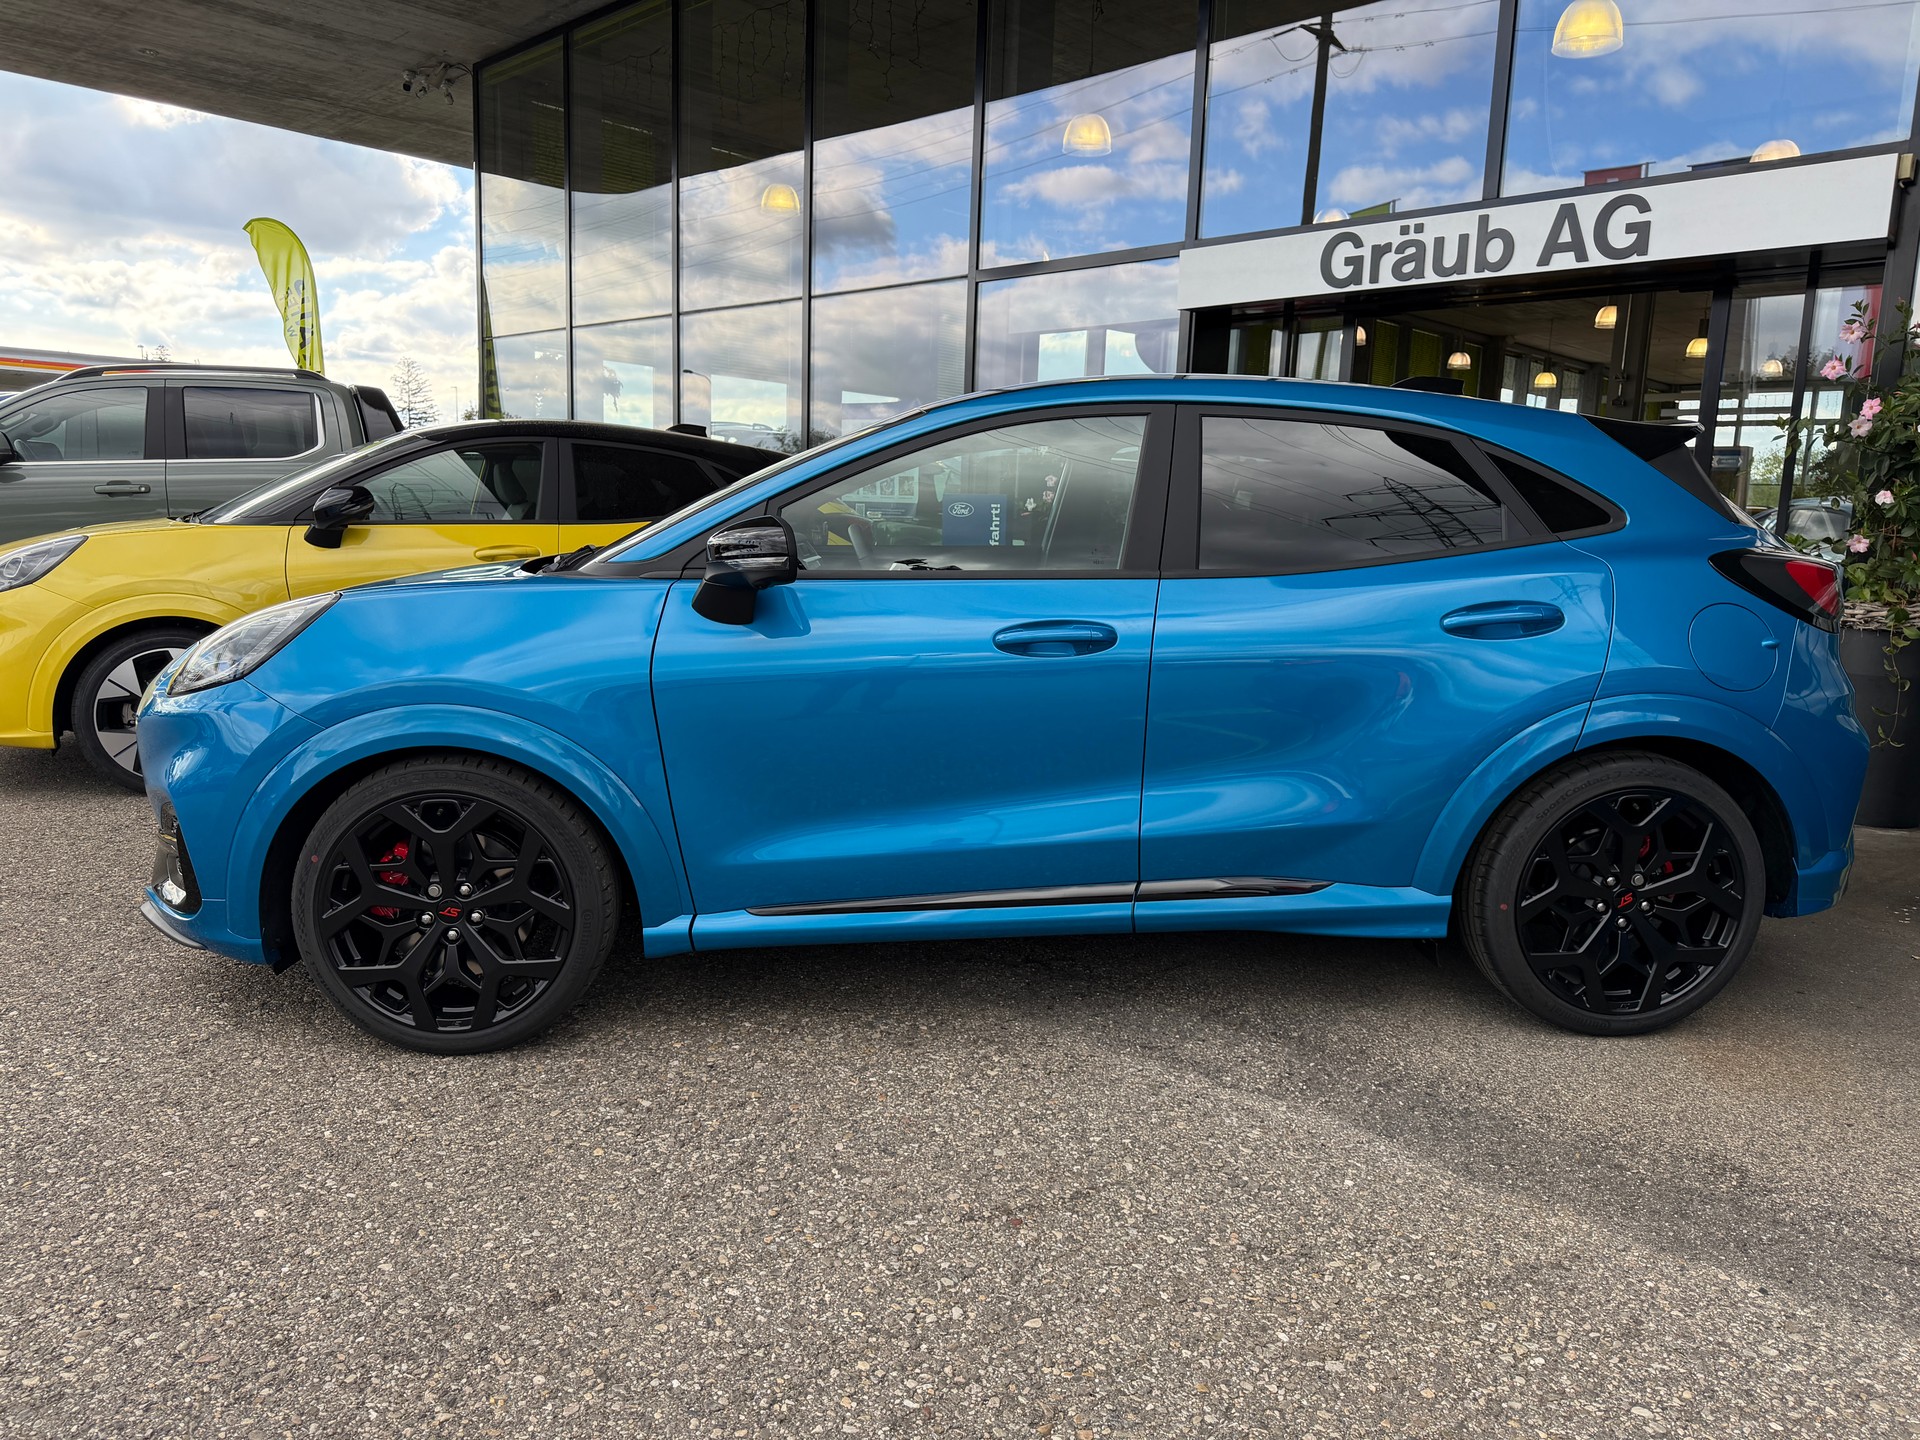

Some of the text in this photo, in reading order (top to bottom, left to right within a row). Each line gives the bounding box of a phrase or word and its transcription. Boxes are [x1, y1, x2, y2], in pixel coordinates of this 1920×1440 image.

[1320, 193, 1652, 289] Gräub AG
[951, 503, 971, 515] Ford
[989, 503, 1001, 546] fahrt!
[438, 906, 462, 917] ST
